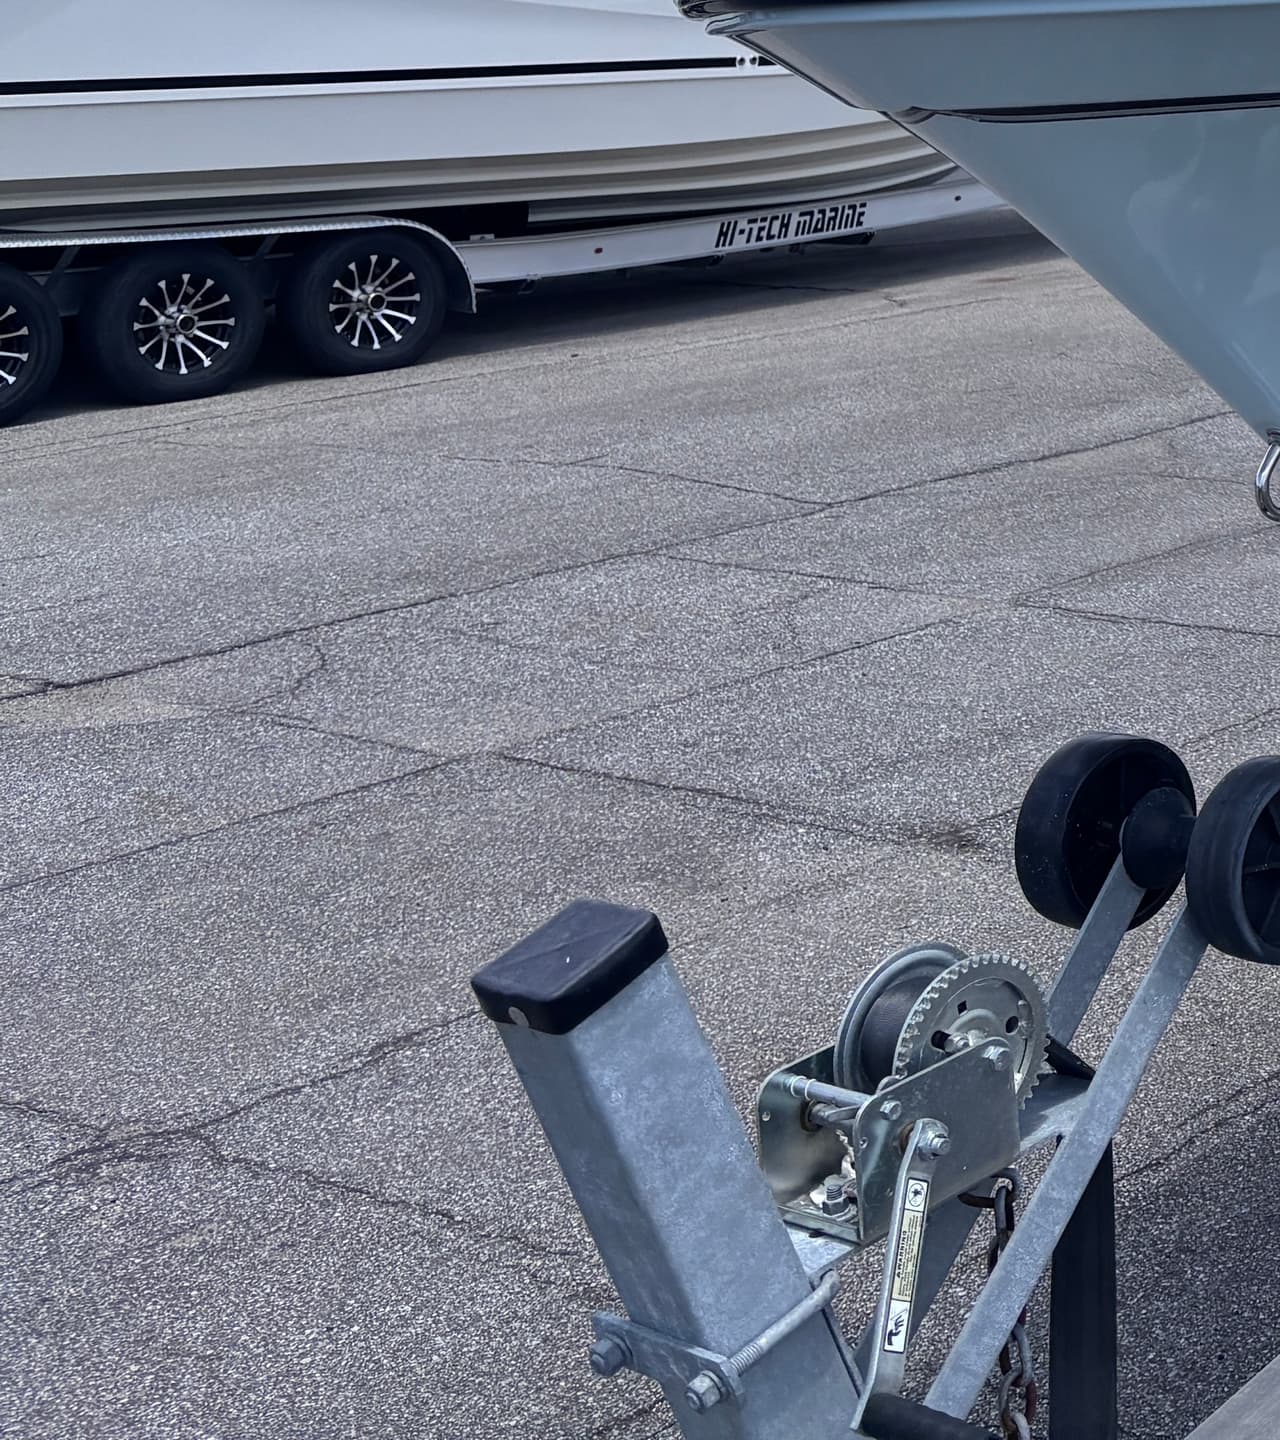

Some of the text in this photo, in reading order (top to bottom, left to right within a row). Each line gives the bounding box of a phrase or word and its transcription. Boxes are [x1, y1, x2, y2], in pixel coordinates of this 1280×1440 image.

[714, 202, 867, 249] HI-TECH MARINE
[897, 1230, 907, 1271] WARNING
